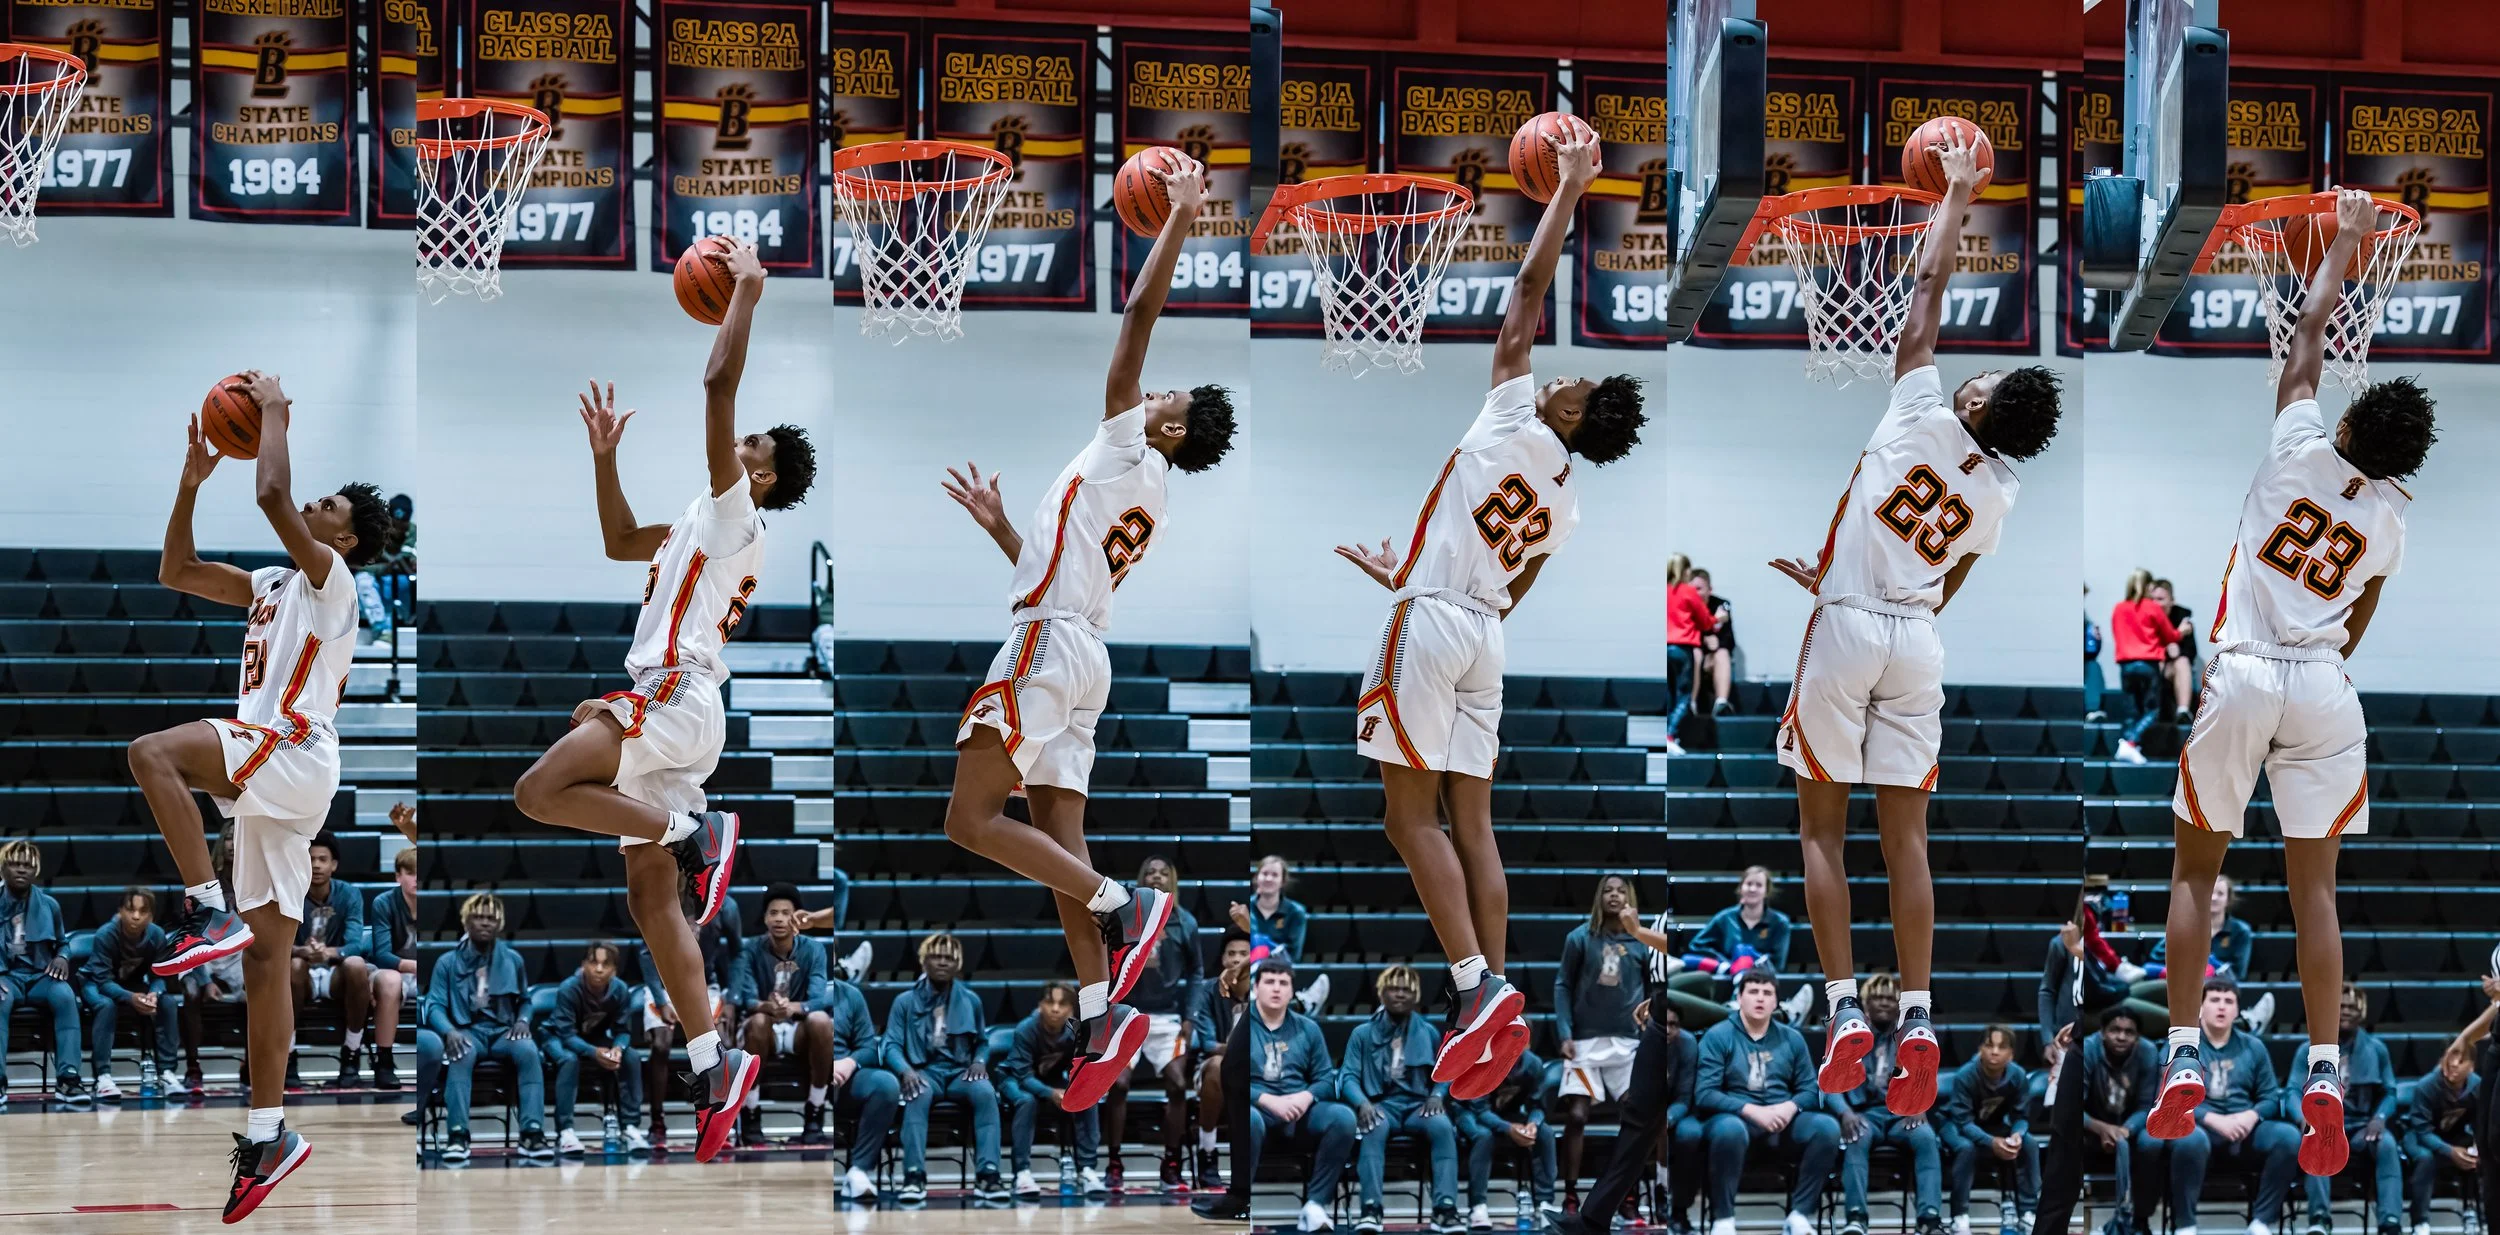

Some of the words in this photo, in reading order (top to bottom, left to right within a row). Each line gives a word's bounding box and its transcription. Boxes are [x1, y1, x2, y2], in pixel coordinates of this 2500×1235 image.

[485, 11, 570, 37] CLASS
[574, 14, 612, 38] 2A
[673, 19, 757, 45] CLASS
[762, 22, 799, 46] 2A
[479, 35, 616, 63] BASEBALL
[668, 41, 805, 70] BASKETBALL
[946, 53, 1032, 79] CLASS
[1035, 57, 1073, 80] 2A
[1135, 62, 1219, 88] CLASS
[941, 78, 1077, 105] BASEBALL
[1321, 82, 1354, 106] 1A
[1407, 86, 1493, 111] CLASS
[1496, 90, 1534, 113] 2A
[1805, 93, 1838, 117] 1A
[239, 106, 310, 124] STATE
[1595, 95, 1667, 119] CLAS
[1891, 97, 1977, 122] CLASS
[1980, 101, 2019, 125] 2A
[2266, 101, 2300, 125] 1A
[2352, 106, 2438, 131] CLASS
[2441, 110, 2480, 133] 2A
[212, 123, 338, 144] CHAMPIONS
[2347, 130, 2484, 158] BASEBALL
[228, 157, 321, 195] 1984
[702, 159, 771, 175] STATE
[674, 175, 800, 196] CHAMPIONS
[691, 209, 783, 247] 1984
[1171, 252, 1244, 288] 984
[1473, 474, 1552, 572] 23
[1874, 463, 1973, 566] 23
[2256, 497, 2368, 601] 23
